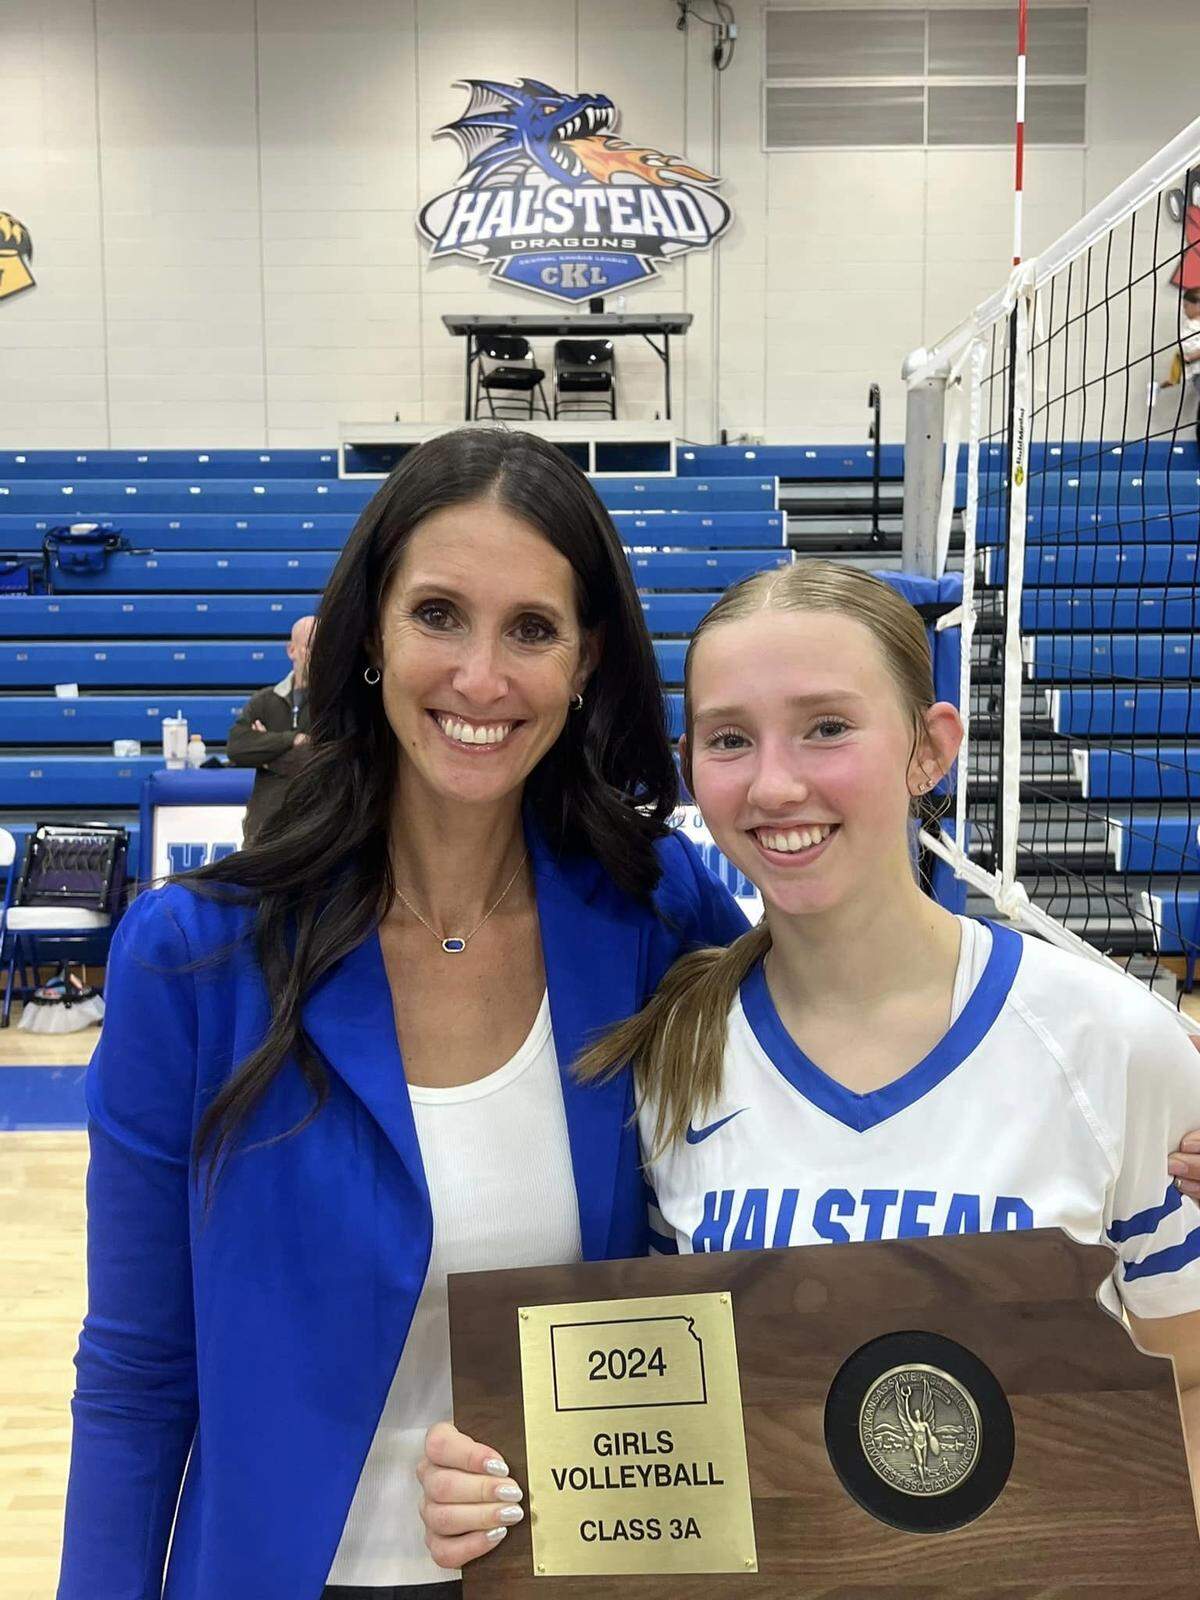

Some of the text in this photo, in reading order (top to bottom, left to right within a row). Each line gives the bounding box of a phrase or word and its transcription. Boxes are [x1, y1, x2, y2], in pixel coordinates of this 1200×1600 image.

[440, 188, 708, 248] HALSTEAD
[510, 237, 636, 249] DRAGONS
[540, 263, 607, 288] CKL
[588, 1347, 667, 1380] 2024
[863, 1384, 889, 1424] KANSAS
[888, 1372, 917, 1388] STATE
[593, 1430, 674, 1456] GIRLS
[551, 1462, 724, 1490] VOLLEYBALL
[580, 1517, 702, 1542] CLASS 3A
